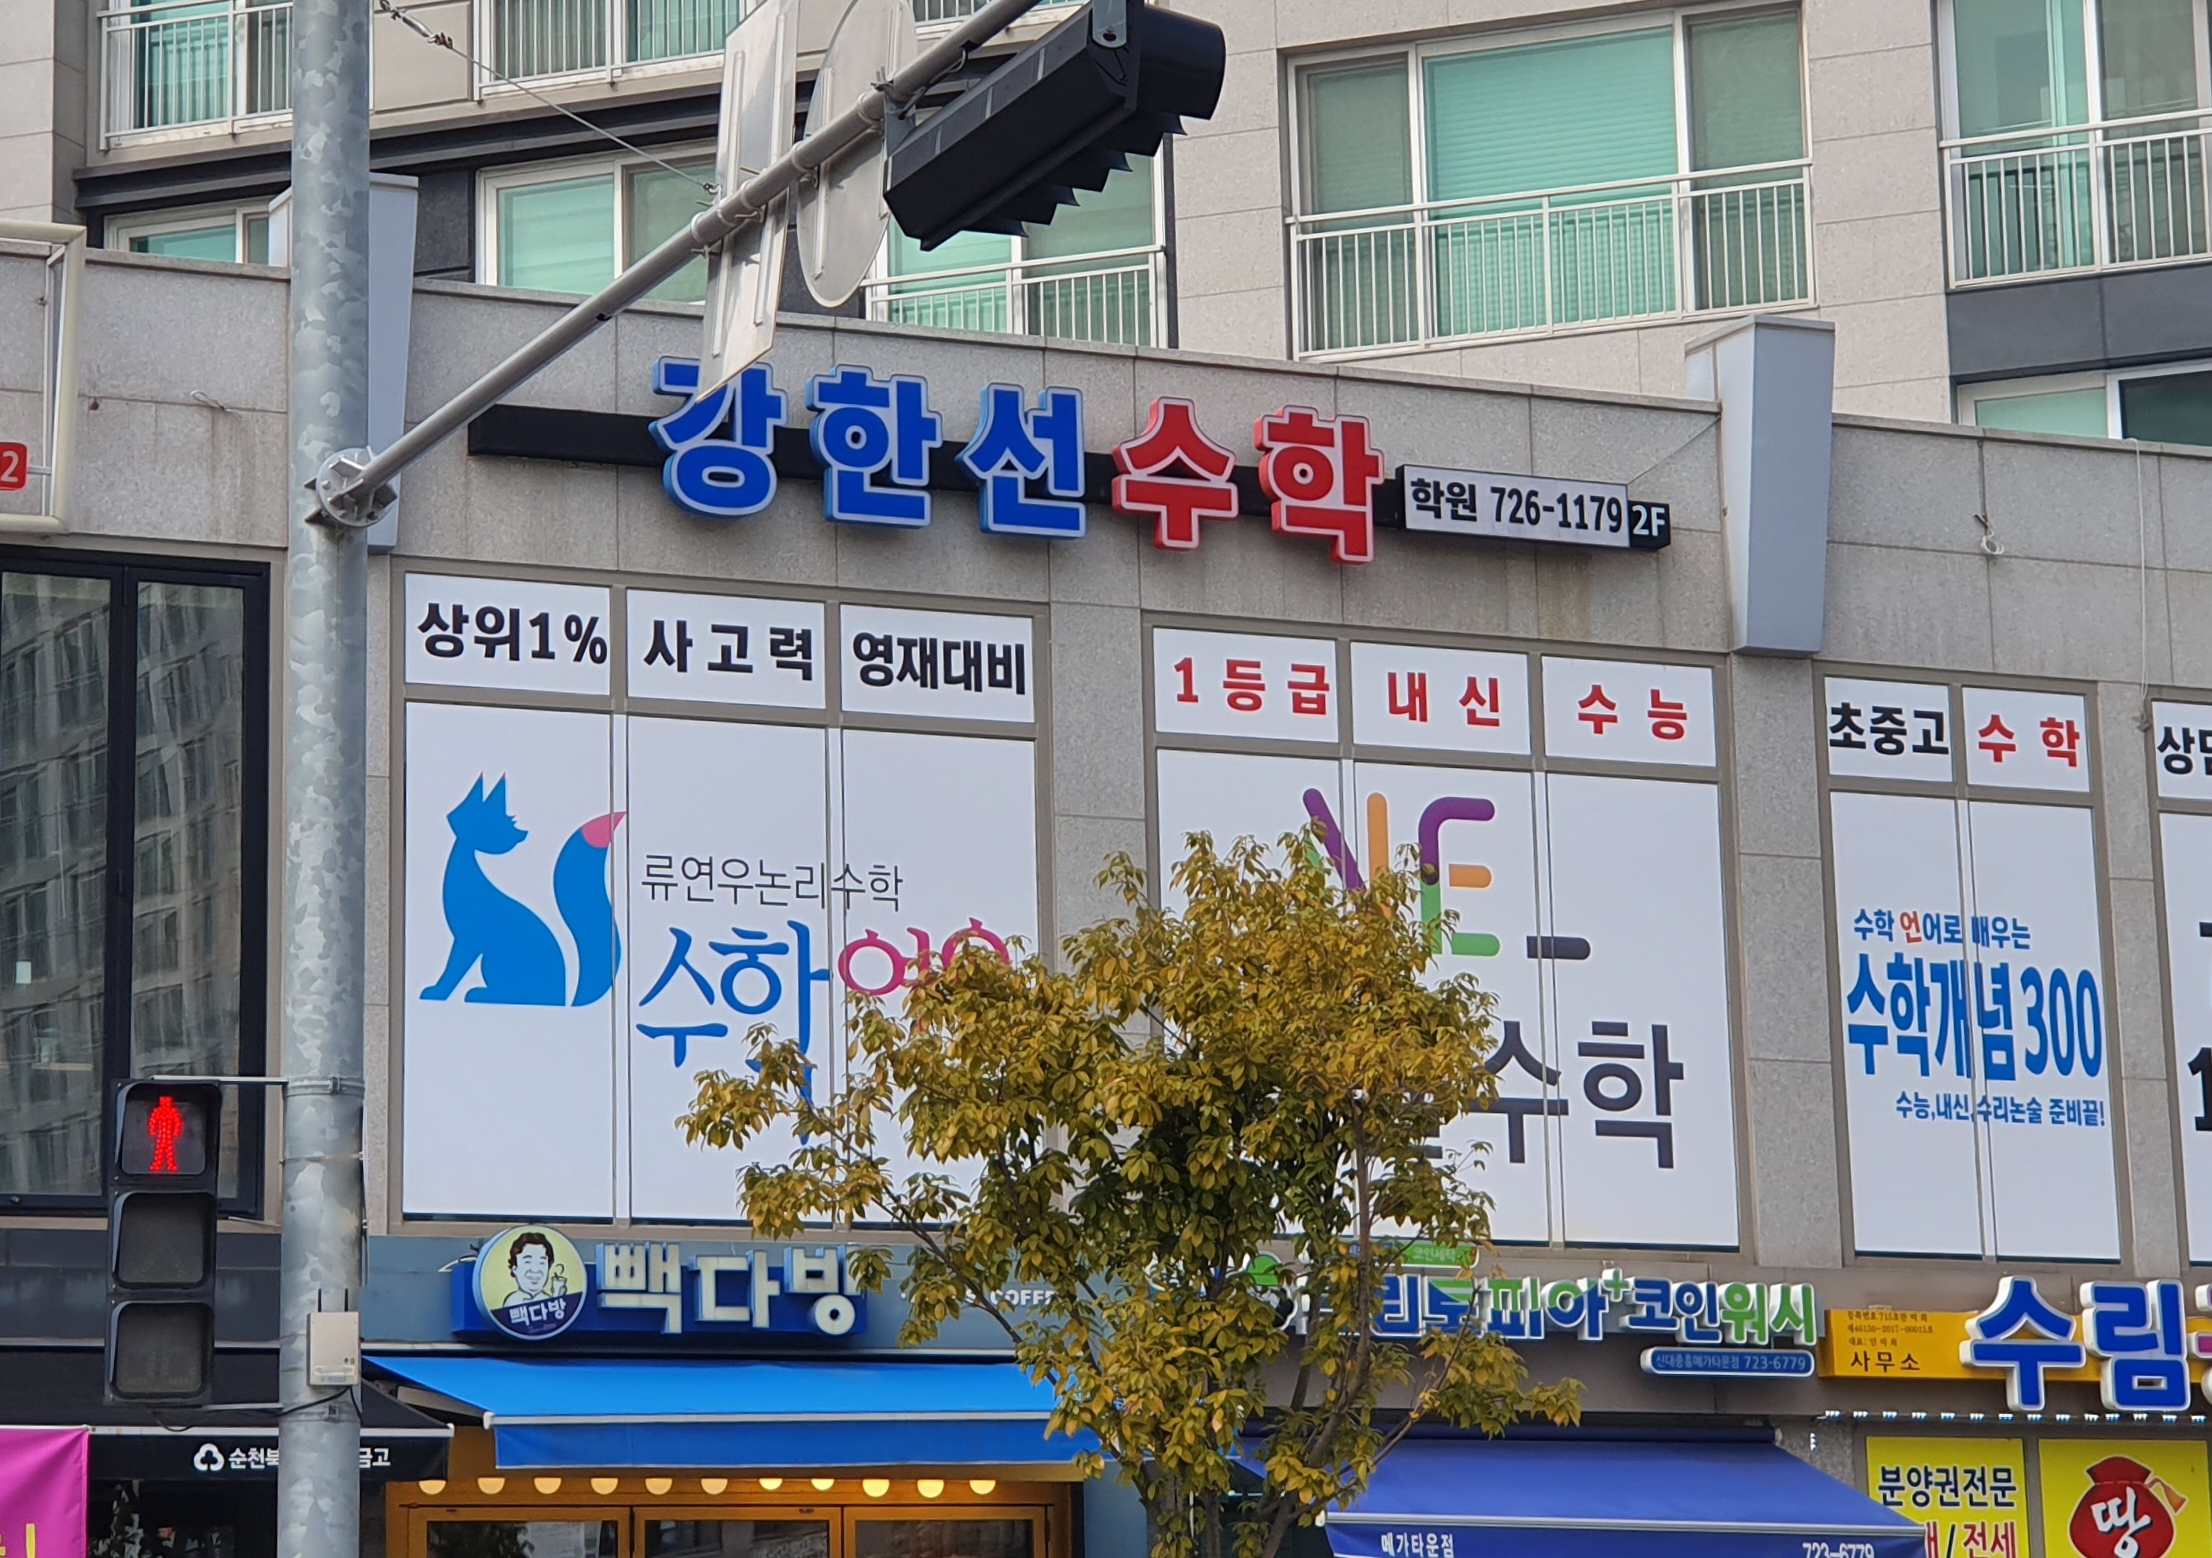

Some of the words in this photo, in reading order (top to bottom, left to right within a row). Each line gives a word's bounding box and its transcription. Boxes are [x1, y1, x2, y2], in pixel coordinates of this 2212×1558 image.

[1112, 396, 1384, 565] 수학
[1410, 478, 1478, 523] 학원
[1490, 487, 1623, 533] 726-1179
[1632, 504, 1667, 537] 2F
[417, 602, 608, 665] 상위1%
[644, 619, 813, 681] 사고력
[852, 631, 1026, 696] 영재대비
[1387, 671, 1501, 728] 내신
[1577, 683, 1688, 741] 수능
[1828, 702, 1950, 756] 초중고
[1977, 714, 2081, 768] 수학
[641, 853, 904, 913] 류연우논리수학
[1853, 908, 1895, 943] 수학
[1899, 911, 1964, 945] 언어로
[1971, 915, 2031, 950] 배우는
[2048, 1098, 2106, 1127] 준비끝!
[509, 1297, 567, 1327] 빽다방
[597, 1243, 866, 1336] 빽다방
[1621, 1277, 1817, 1346] 코인워시
[1743, 1355, 1806, 1371] 723-6779
[1850, 1350, 1921, 1373] 사무소
[1877, 1465, 2017, 1509] 분양권전문
[1381, 1531, 1455, 1558] 메가타운점
